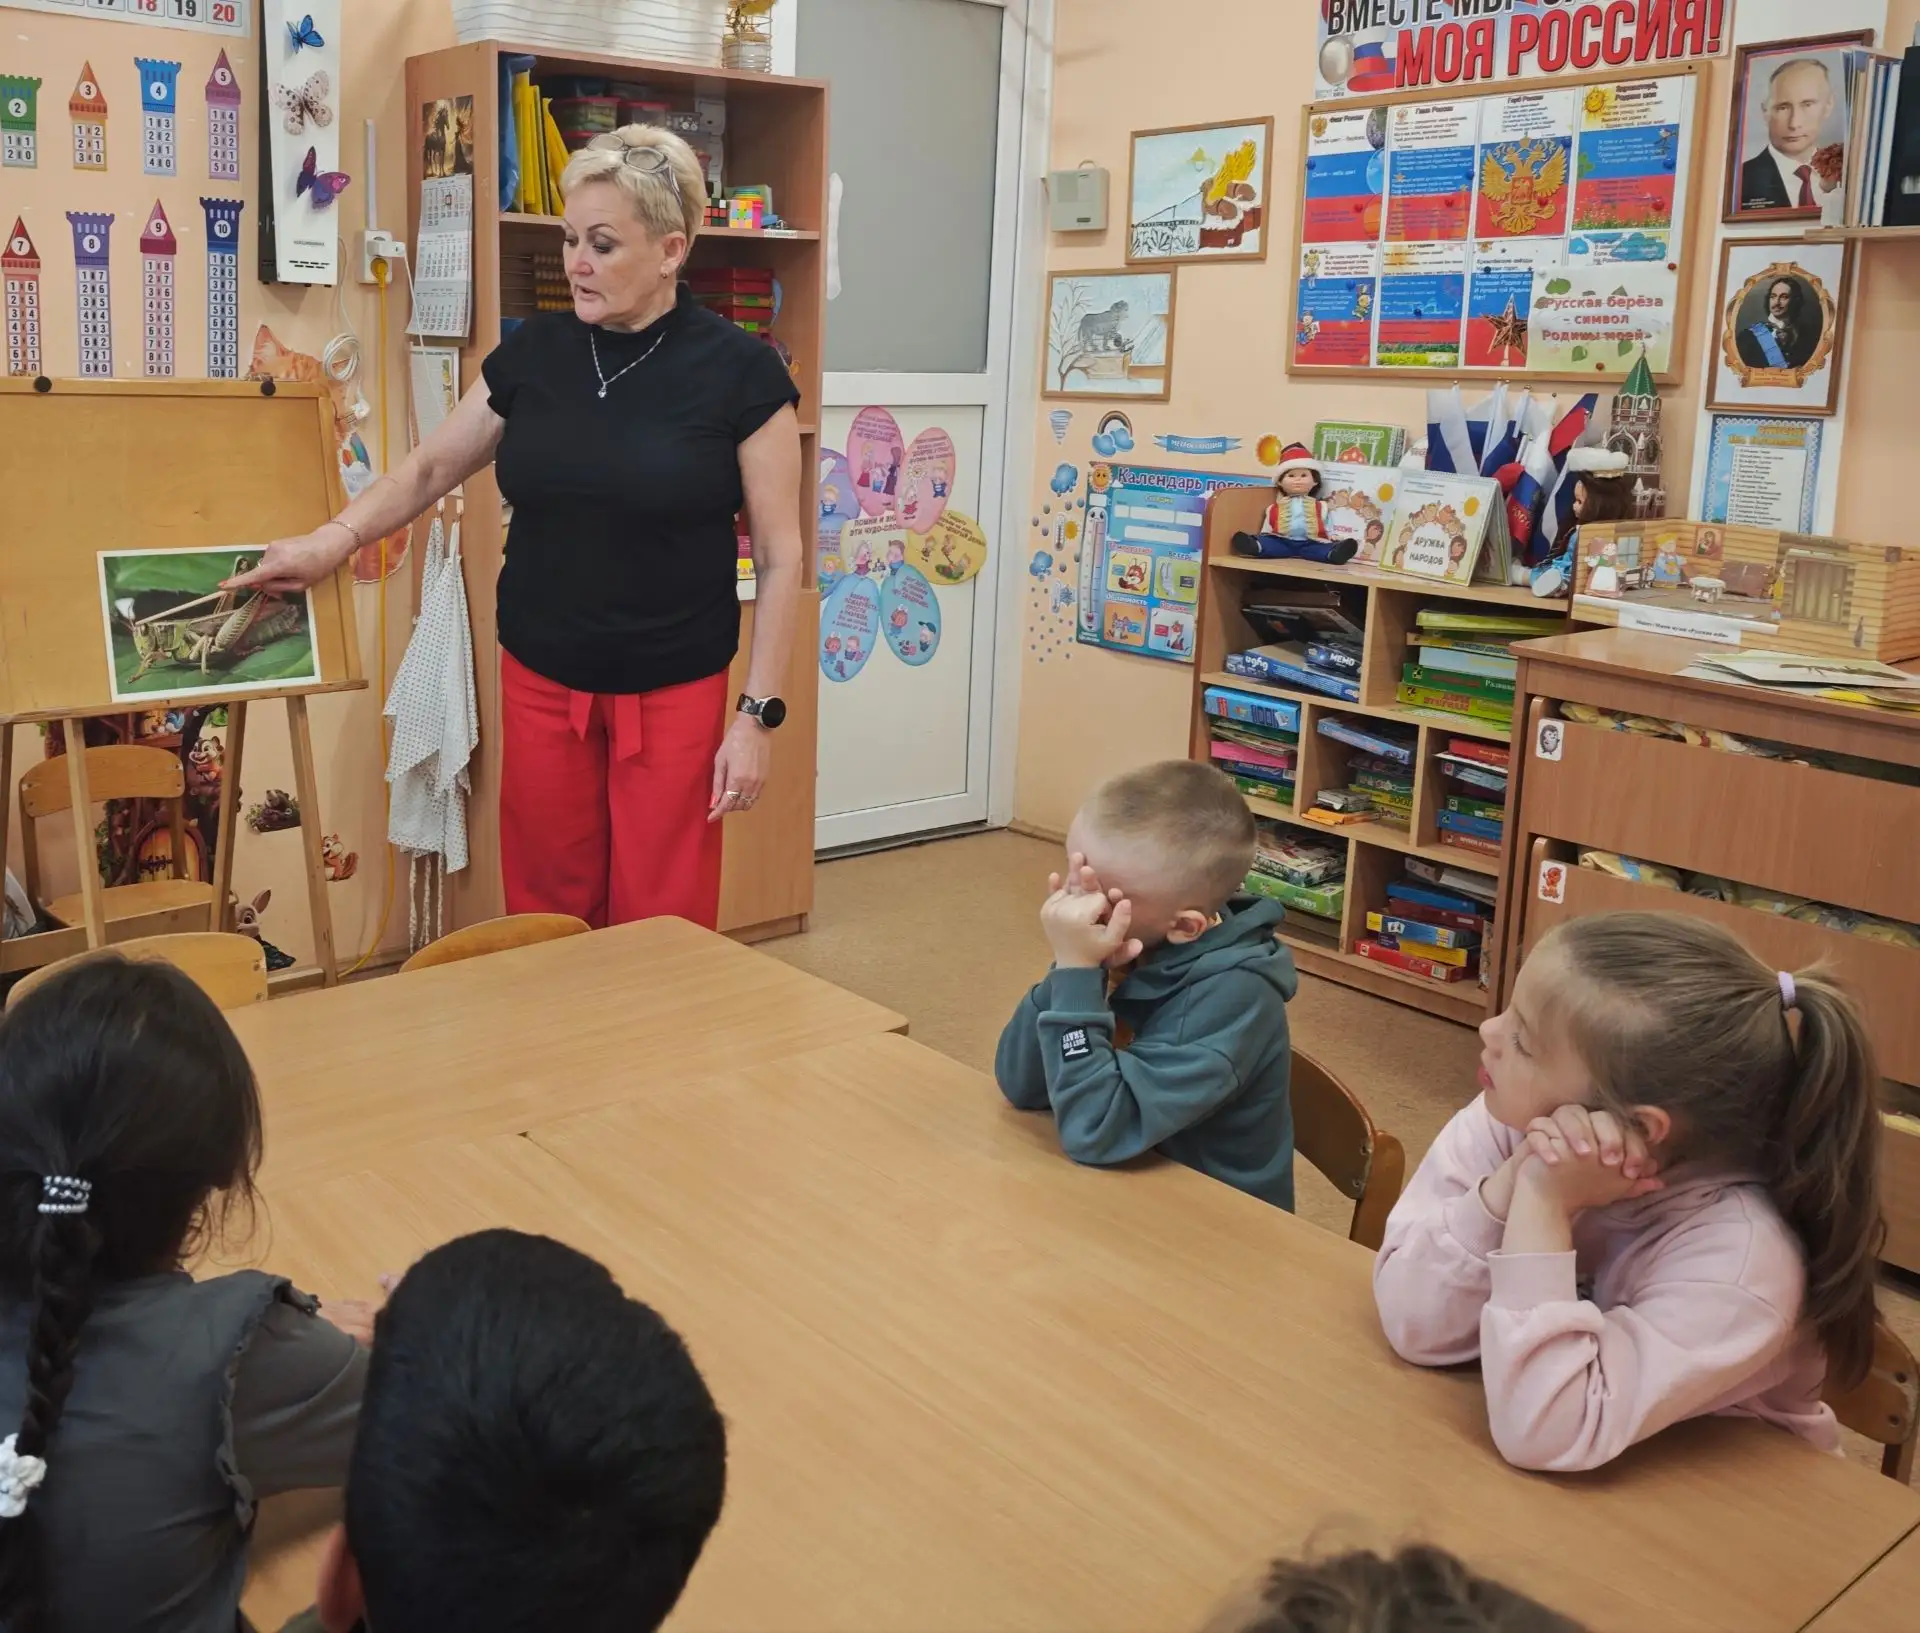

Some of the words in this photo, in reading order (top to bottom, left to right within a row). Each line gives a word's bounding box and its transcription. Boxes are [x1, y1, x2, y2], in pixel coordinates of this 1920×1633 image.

[138, 0, 157, 12] 18
[176, 0, 196, 17] 19
[212, 4, 235, 22] 20
[1397, 18, 1494, 88] МОЯ
[1508, 0, 1724, 76] РОССИЯ!
[220, 71, 226, 82] 5
[85, 85, 91, 95] 3
[156, 85, 161, 96] 4
[14, 102, 21, 113] 2
[213, 110, 217, 119] 1
[228, 112, 234, 121] 4
[149, 118, 153, 126] 1
[164, 119, 170, 128] 3
[78, 126, 82, 134] 1
[95, 127, 100, 135] 2
[213, 124, 219, 132] 2
[228, 125, 234, 134] 3
[8, 136, 12, 144] 1
[25, 137, 30, 145] 1
[149, 131, 154, 140] 2
[165, 133, 171, 141] 2
[78, 139, 84, 148] 2
[96, 141, 100, 149] 1
[213, 137, 219, 145] 3
[229, 138, 234, 147] 2
[7, 149, 14, 159] 2
[26, 151, 31, 160] 0
[149, 145, 155, 154] 3
[166, 146, 170, 154] 1
[213, 150, 219, 159] 4
[230, 151, 234, 159] 1
[79, 153, 84, 162] 3
[96, 154, 101, 163] 0
[149, 158, 155, 167] 4
[165, 159, 171, 168] 0
[213, 163, 219, 172] 5
[229, 164, 234, 173] 0
[155, 222, 162, 232] 9
[217, 224, 228, 234] 10
[17, 241, 24, 252] 7
[88, 238, 95, 249] 8
[213, 255, 217, 263] 1
[227, 255, 233, 264] 9
[148, 261, 153, 270] 1
[163, 262, 170, 271] 8
[82, 271, 87, 279] 1
[98, 271, 104, 281] 7
[212, 268, 218, 276] 2
[227, 268, 233, 277] 8
[147, 274, 154, 283] 2
[164, 276, 169, 284] 7
[11, 282, 15, 291] 1
[27, 282, 34, 291] 6
[82, 284, 88, 294] 2
[99, 285, 105, 294] 6
[212, 280, 218, 289] 3
[227, 281, 233, 289] 7
[148, 287, 154, 296] 3
[164, 288, 170, 297] 6
[11, 296, 17, 305] 2
[28, 296, 34, 305] 5
[83, 298, 89, 307] 3
[99, 298, 105, 307] 5
[212, 293, 218, 301] 4
[227, 293, 233, 302] 6
[1607, 295, 1664, 310] берёза
[148, 300, 154, 309] 4
[164, 301, 170, 310] 5
[12, 309, 18, 318] 3
[28, 309, 35, 318] 4
[83, 311, 89, 319] 4
[99, 311, 105, 319] 4
[212, 306, 218, 314] 5
[227, 306, 234, 315] 5
[148, 313, 154, 322] 5
[164, 315, 170, 323] 4
[212, 318, 218, 327] 6
[227, 319, 234, 327] 4
[1575, 314, 1629, 325] символ
[12, 322, 18, 331] 4
[29, 323, 35, 332] 3
[84, 324, 90, 333] 5
[100, 324, 106, 333] 3
[148, 326, 154, 336] 6
[164, 327, 170, 336] 3
[12, 336, 19, 344] 5
[30, 336, 36, 345] 2
[212, 331, 218, 339] 7
[228, 331, 234, 340] 3
[1542, 329, 1600, 342] Родины
[84, 337, 90, 346] 6
[100, 338, 106, 347] 2
[148, 340, 154, 348] 7
[164, 340, 170, 349] 2
[212, 343, 218, 352] 8
[228, 344, 234, 353] 2
[13, 350, 19, 359] 6
[31, 350, 35, 359] 1
[84, 350, 90, 360] 7
[101, 351, 106, 359] 1
[148, 352, 154, 361] 8
[165, 353, 169, 361] 1
[212, 356, 218, 365] 9
[228, 357, 233, 365] 1
[14, 363, 19, 372] 7
[31, 363, 37, 371] 0
[85, 364, 91, 373] 8
[101, 364, 107, 373] 0
[148, 365, 154, 374] 9
[165, 366, 170, 375] 0
[212, 369, 220, 377] 10
[228, 369, 234, 378] 0
[1117, 467, 1202, 493] Календарь
[1414, 536, 1445, 549] ДРУЖБА
[1409, 552, 1444, 565] НАРОДОВ
